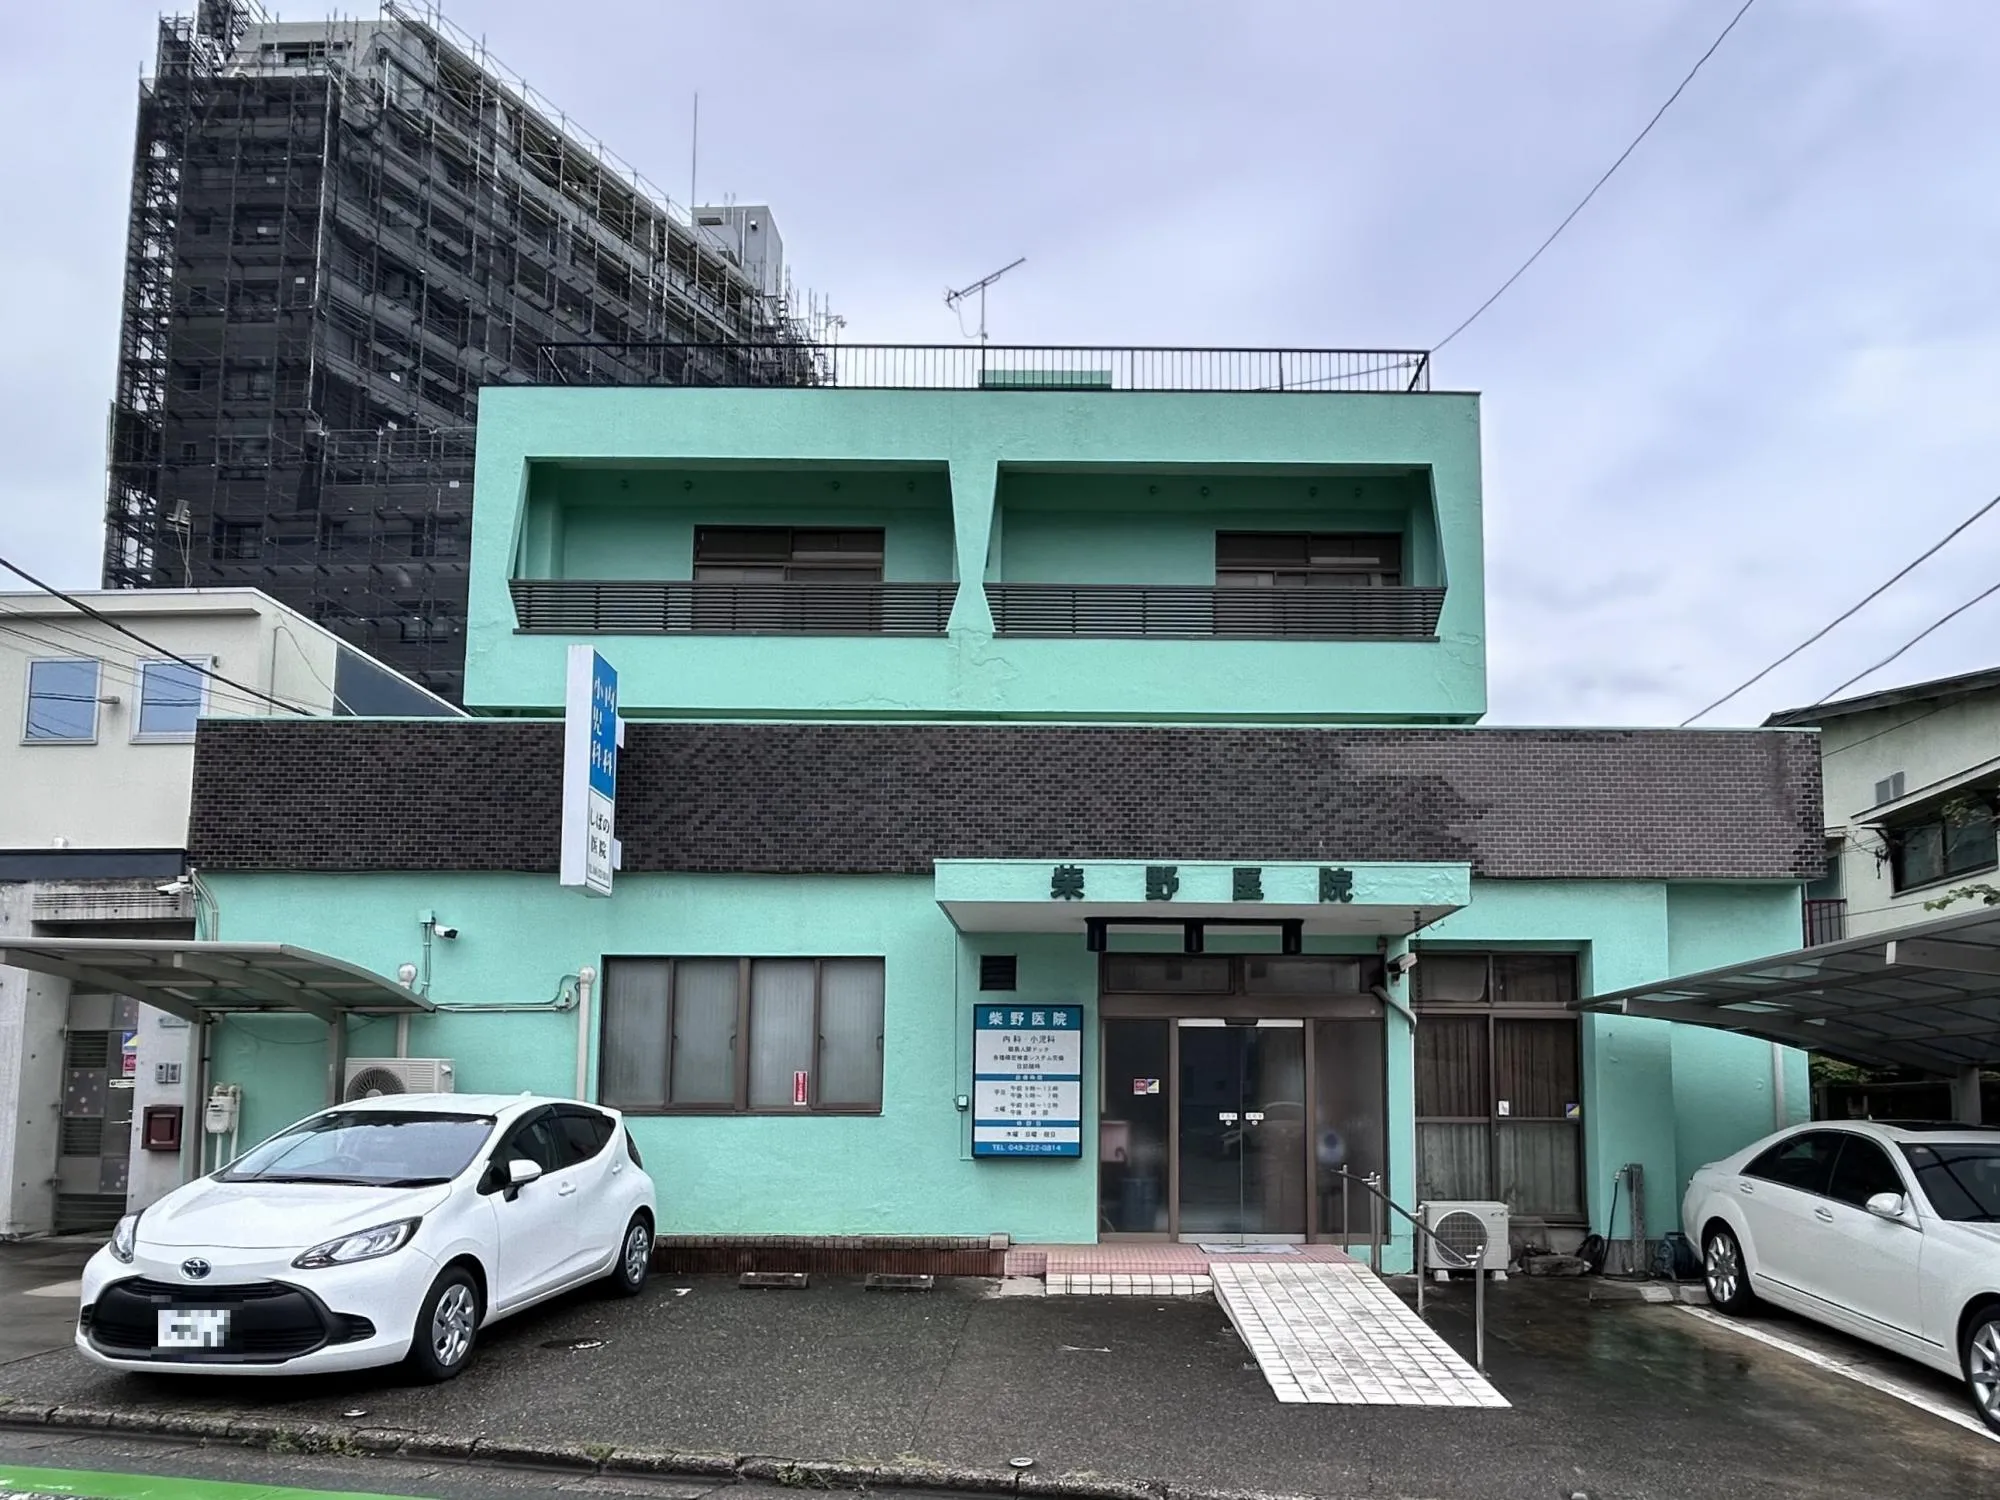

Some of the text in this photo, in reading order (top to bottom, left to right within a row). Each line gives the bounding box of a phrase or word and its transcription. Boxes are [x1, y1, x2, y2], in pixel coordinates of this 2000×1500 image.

[590, 807, 610, 834] しばの
[590, 835, 607, 859] 医院
[1050, 864, 1354, 903] 柴野医院
[988, 1011, 1067, 1026] 柴野医院
